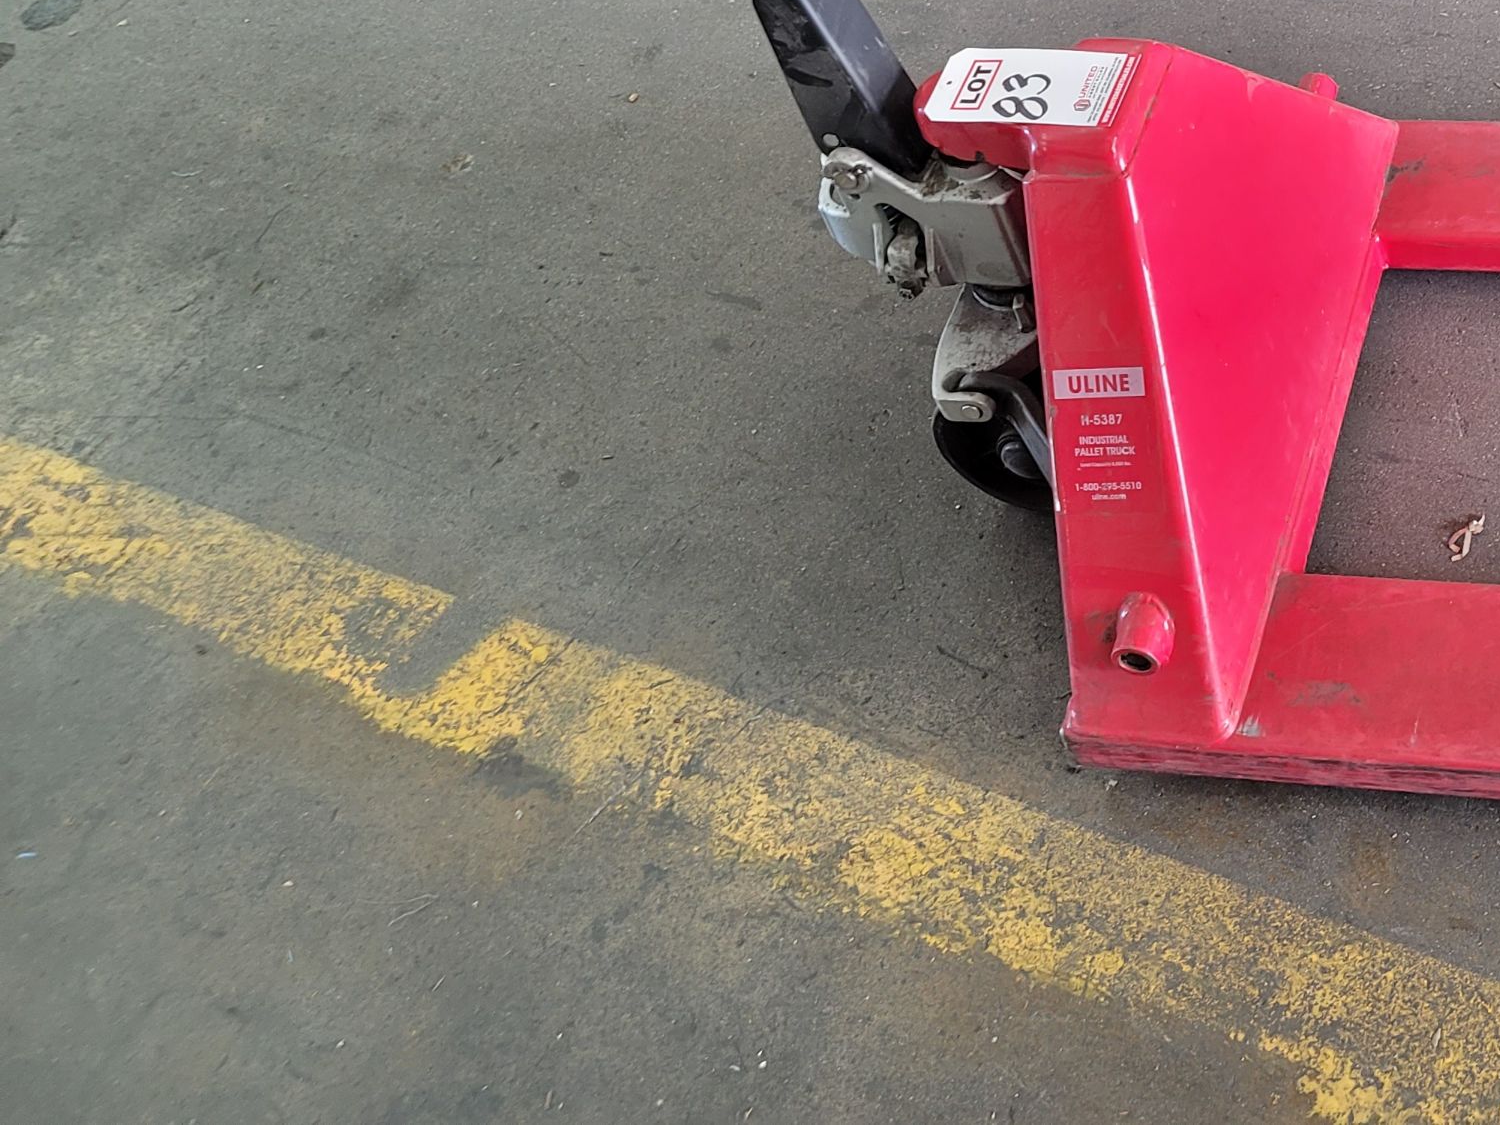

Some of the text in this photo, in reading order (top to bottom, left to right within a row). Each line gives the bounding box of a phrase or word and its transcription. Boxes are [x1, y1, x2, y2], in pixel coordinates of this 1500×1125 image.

[960, 65, 993, 104] LOT
[1079, 65, 1099, 99] UNITED
[992, 73, 1052, 121] 83
[1068, 373, 1130, 394] ULINE
[1080, 413, 1123, 426] H-5387
[1079, 435, 1129, 445] INDUSTRIAL
[1074, 445, 1136, 457] PALLET TRUCK
[1074, 481, 1142, 492] 1-800-295-5510
